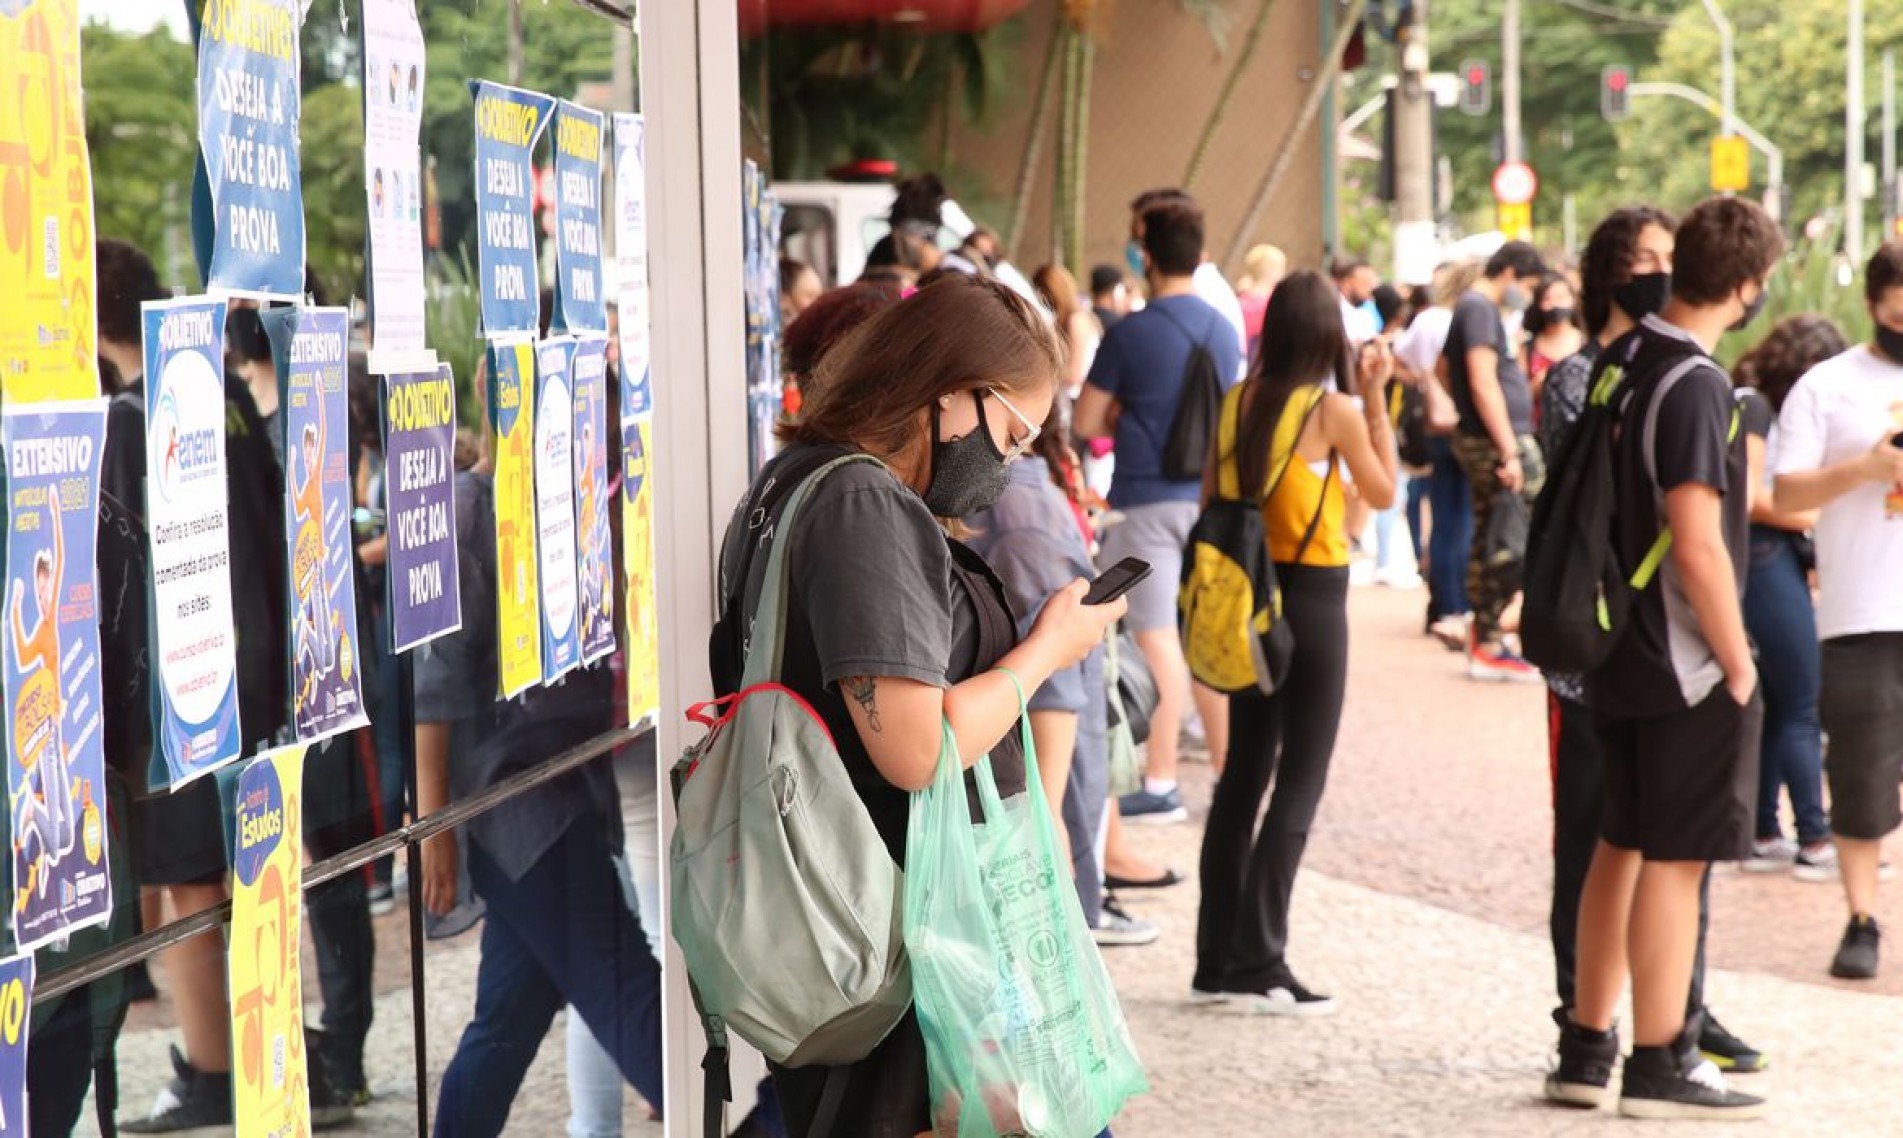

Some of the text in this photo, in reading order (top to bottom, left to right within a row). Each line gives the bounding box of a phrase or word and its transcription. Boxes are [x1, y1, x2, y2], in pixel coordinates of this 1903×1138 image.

[215, 67, 284, 123] DESEJA A
[220, 125, 290, 191] VOCÊ BOA
[487, 158, 524, 198] DESEJA A
[562, 170, 589, 207] DESEJA
[230, 205, 281, 255] PROVA
[486, 200, 529, 249] VOCÊ BOA
[562, 209, 583, 253] VOCÊ
[495, 265, 526, 300] PROVA
[289, 332, 341, 363] EXTENSIVO
[12, 435, 92, 478] EXTENSIVO
[178, 428, 217, 471] enem
[399, 445, 447, 491] DESEJA A
[397, 493, 449, 551] VOCÊ BOA
[408, 560, 443, 607] PROVA
[241, 803, 281, 849] Estudos
